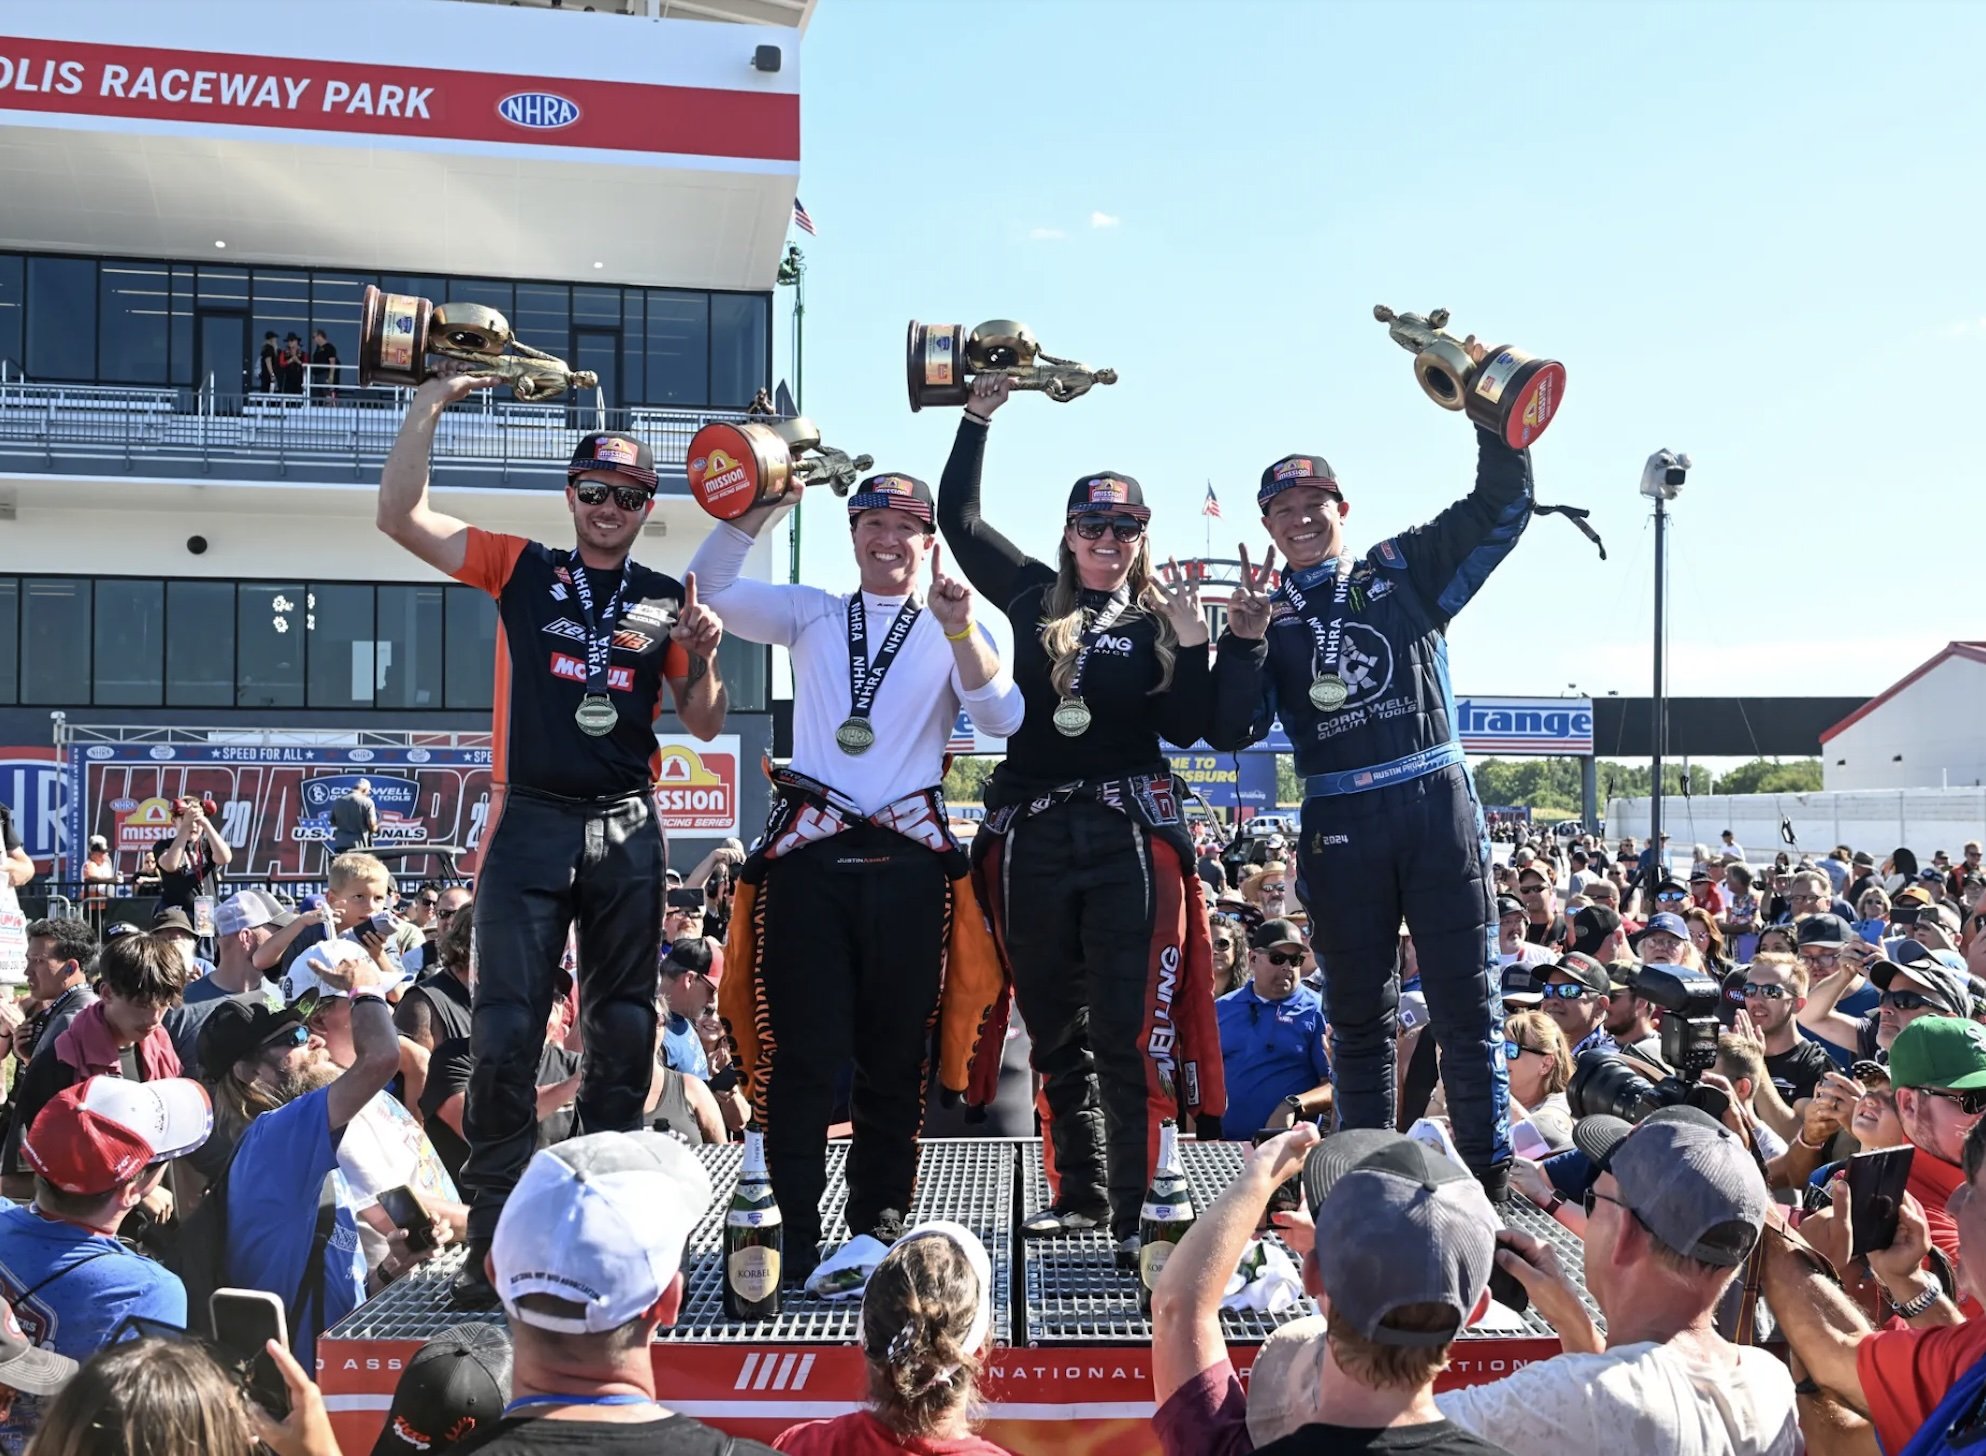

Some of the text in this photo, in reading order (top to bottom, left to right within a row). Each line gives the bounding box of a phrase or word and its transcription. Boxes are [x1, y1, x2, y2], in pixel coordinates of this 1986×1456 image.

[100, 64, 311, 110] RACEWAY
[322, 80, 435, 119] PARK
[507, 95, 573, 125] NHRA
[572, 567, 594, 610] NHRA
[1284, 578, 1306, 611] NHRA
[851, 601, 864, 641] NHRA
[884, 613, 915, 654] NHRA
[1325, 617, 1342, 664] NHRA
[553, 656, 629, 688] MOUL
[857, 666, 885, 709] NHRA
[1318, 704, 1417, 740] QUALITY TOOLS
[224, 748, 303, 760] SPEED FOR ALL
[1195, 757, 1216, 769] TO
[1373, 767, 1402, 780] AUSTIN
[222, 801, 251, 847] 20
[694, 818, 733, 827] SERIES
[1323, 834, 1349, 845] 2024
[1149, 945, 1180, 1083] MELLING
[738, 1268, 771, 1278] KORBEL
[989, 1366, 1146, 1380] NATIONAL
